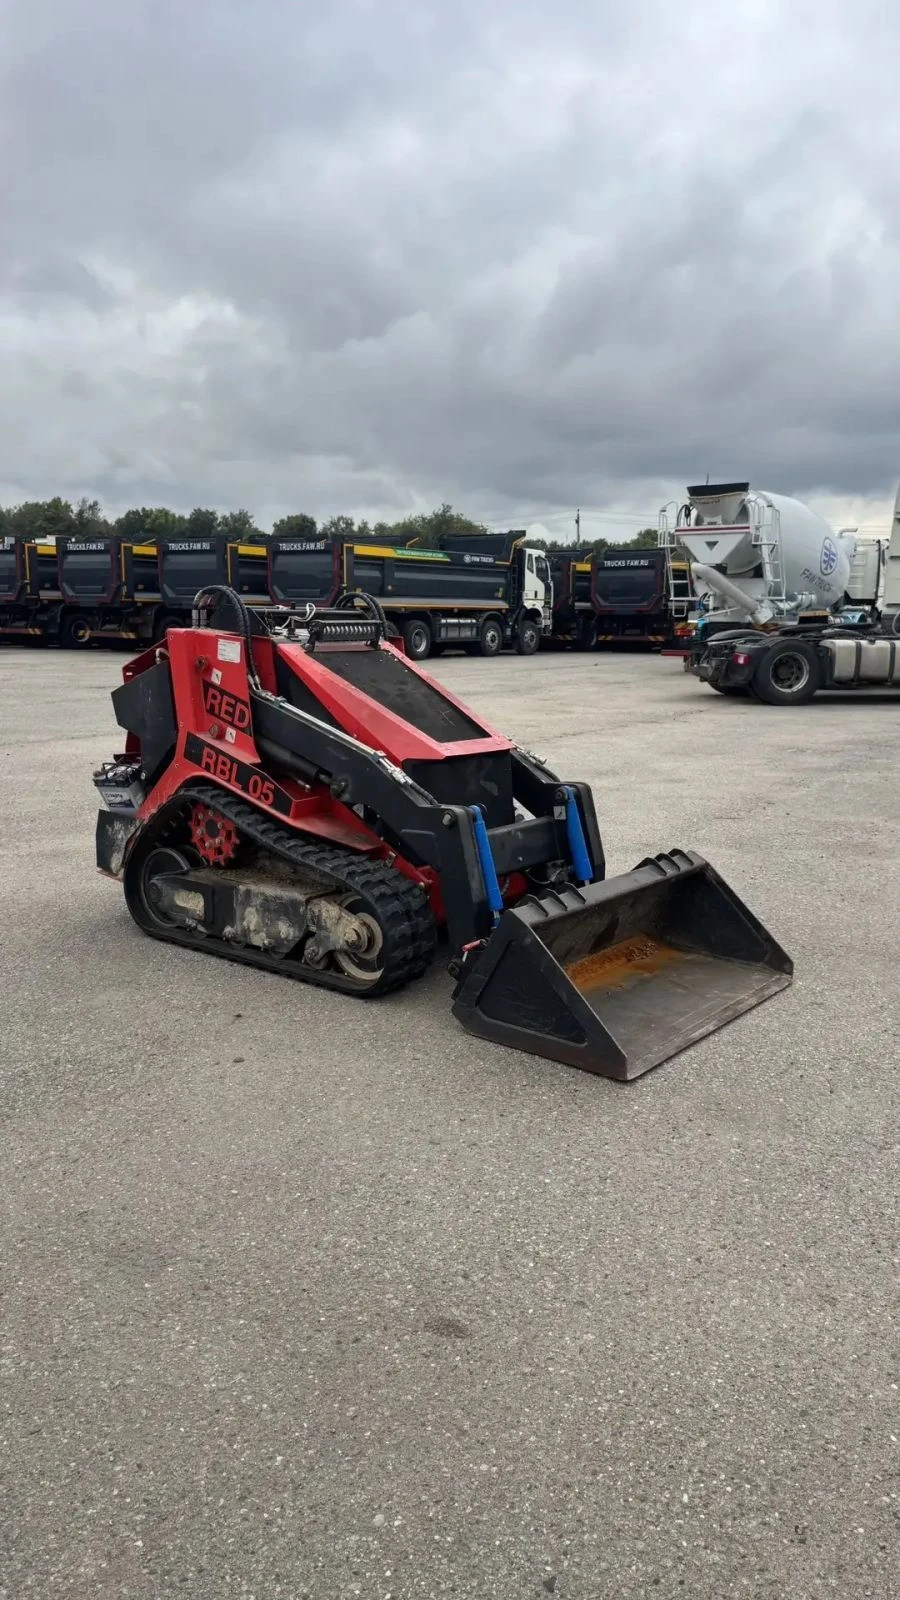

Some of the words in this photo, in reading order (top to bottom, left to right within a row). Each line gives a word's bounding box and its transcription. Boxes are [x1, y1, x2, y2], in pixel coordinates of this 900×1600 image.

[279, 542, 325, 551] TRUCKS.FAW.RU
[206, 687, 250, 729] RED
[201, 745, 242, 790] RBL
[248, 774, 275, 805] 05
